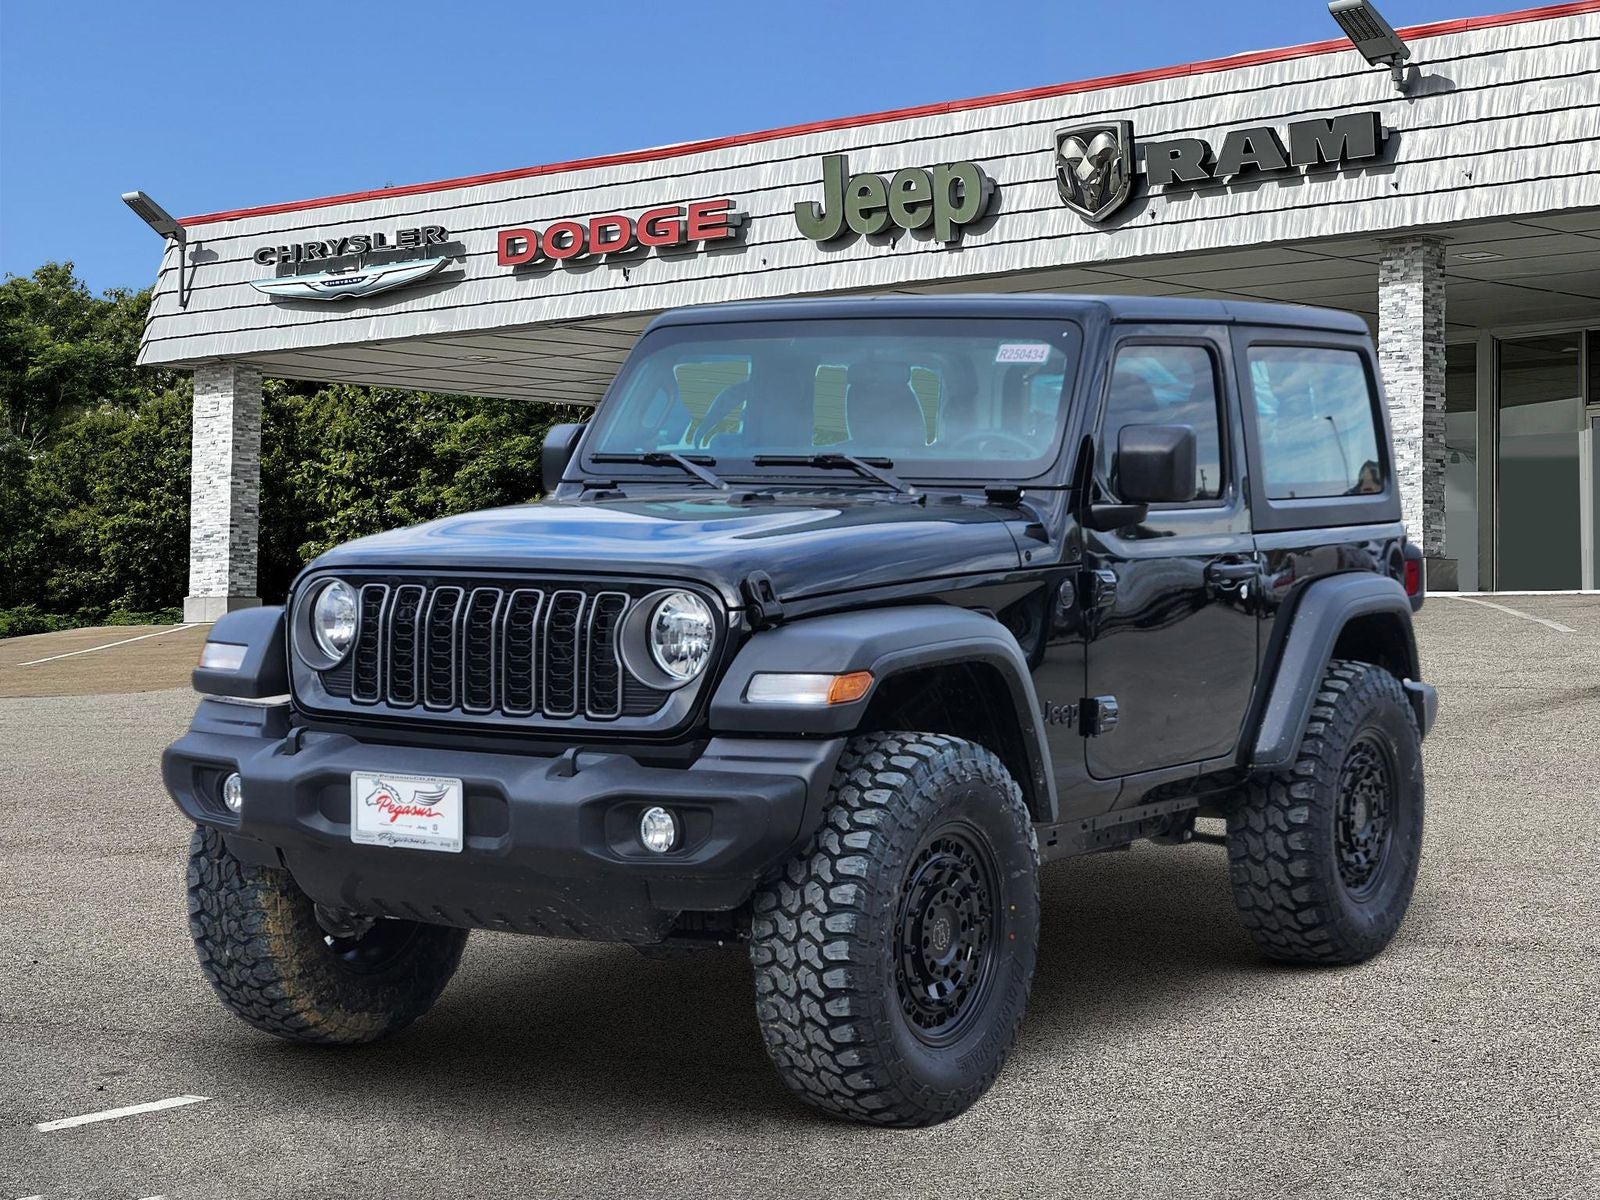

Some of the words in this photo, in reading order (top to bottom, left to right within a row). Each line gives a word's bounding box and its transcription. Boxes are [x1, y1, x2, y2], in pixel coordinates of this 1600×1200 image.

[1146, 112, 1380, 186] RAM
[794, 155, 988, 242] Jeep
[253, 225, 449, 267] CHRYSLER
[497, 199, 736, 267] DODGE
[376, 795, 444, 823] Pegasus
